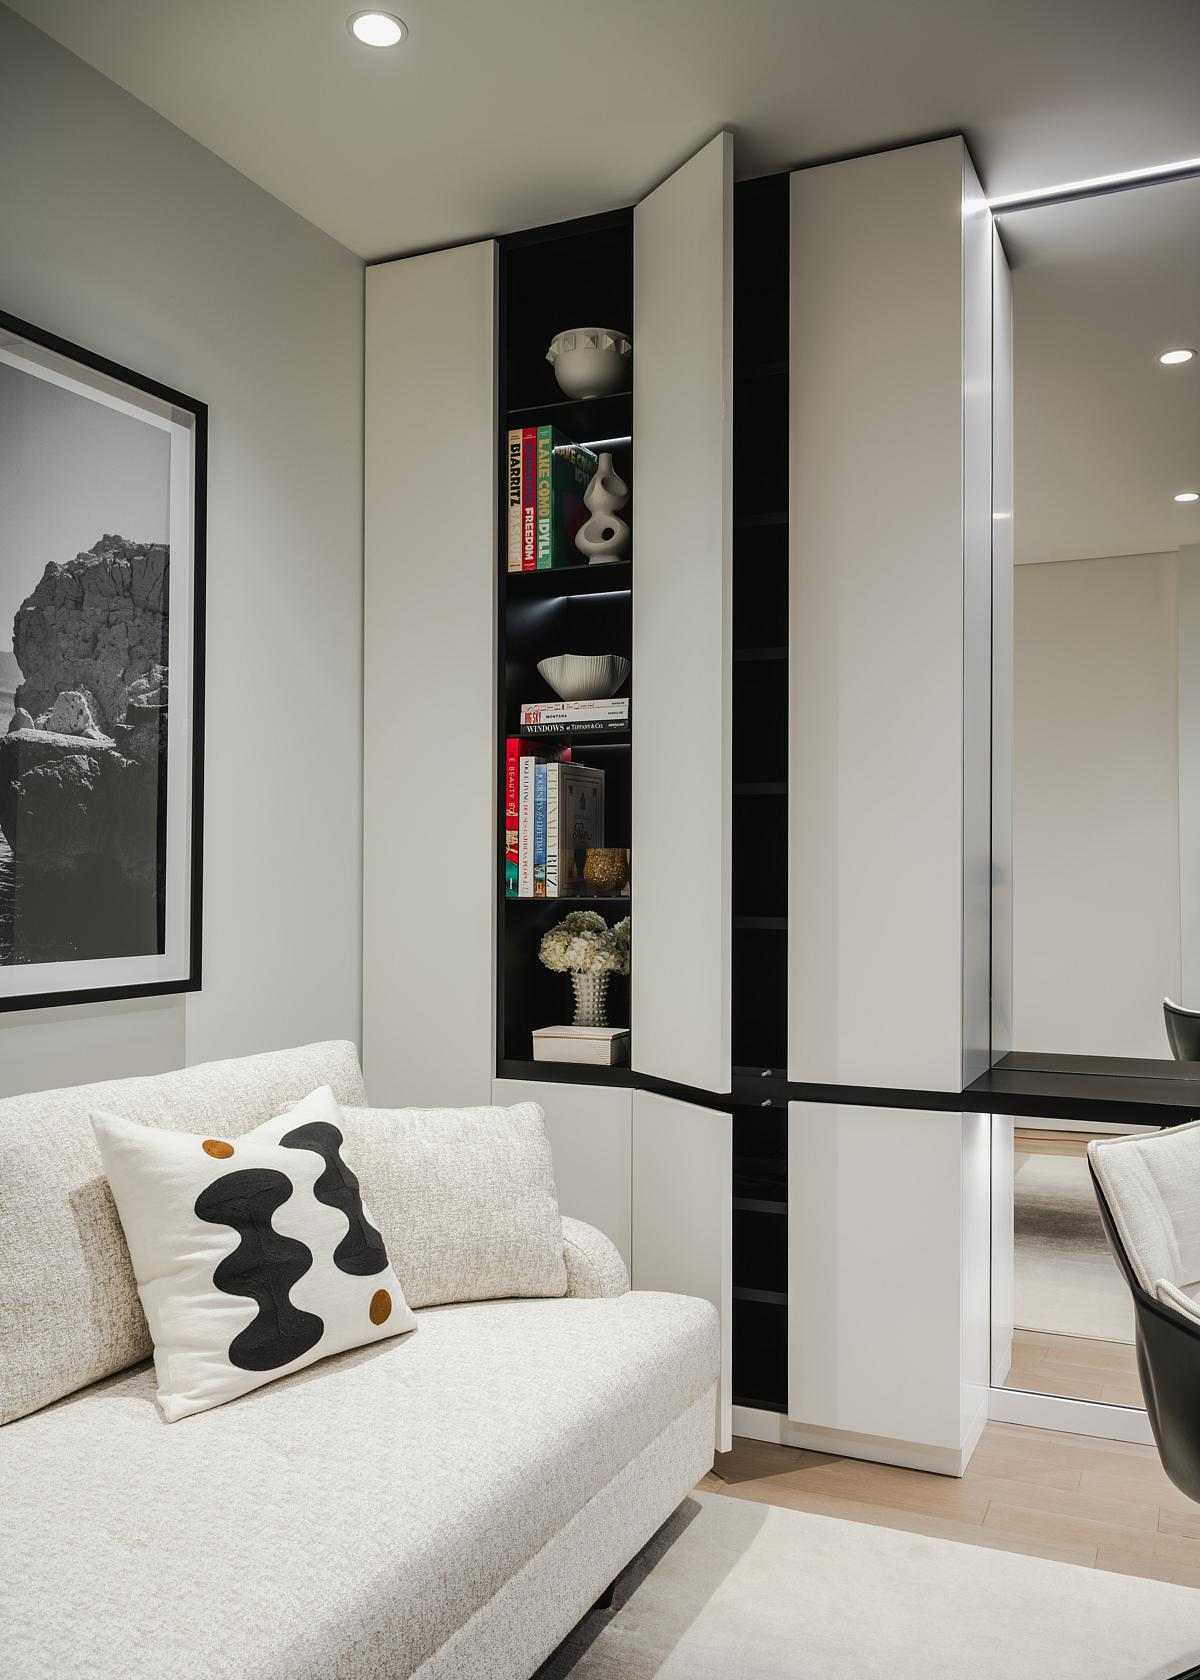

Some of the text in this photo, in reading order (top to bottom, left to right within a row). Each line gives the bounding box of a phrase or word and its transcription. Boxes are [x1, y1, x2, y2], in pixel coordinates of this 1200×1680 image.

[510, 443, 521, 507] BIARRITZ
[538, 439, 551, 558] LAKE COMO IDYLL
[525, 507, 534, 560] FREEDOM
[527, 723, 565, 733] WINDOWS
[508, 766, 516, 799] BEAUTY
[547, 768, 558, 887] ETERNALLY RITZ
